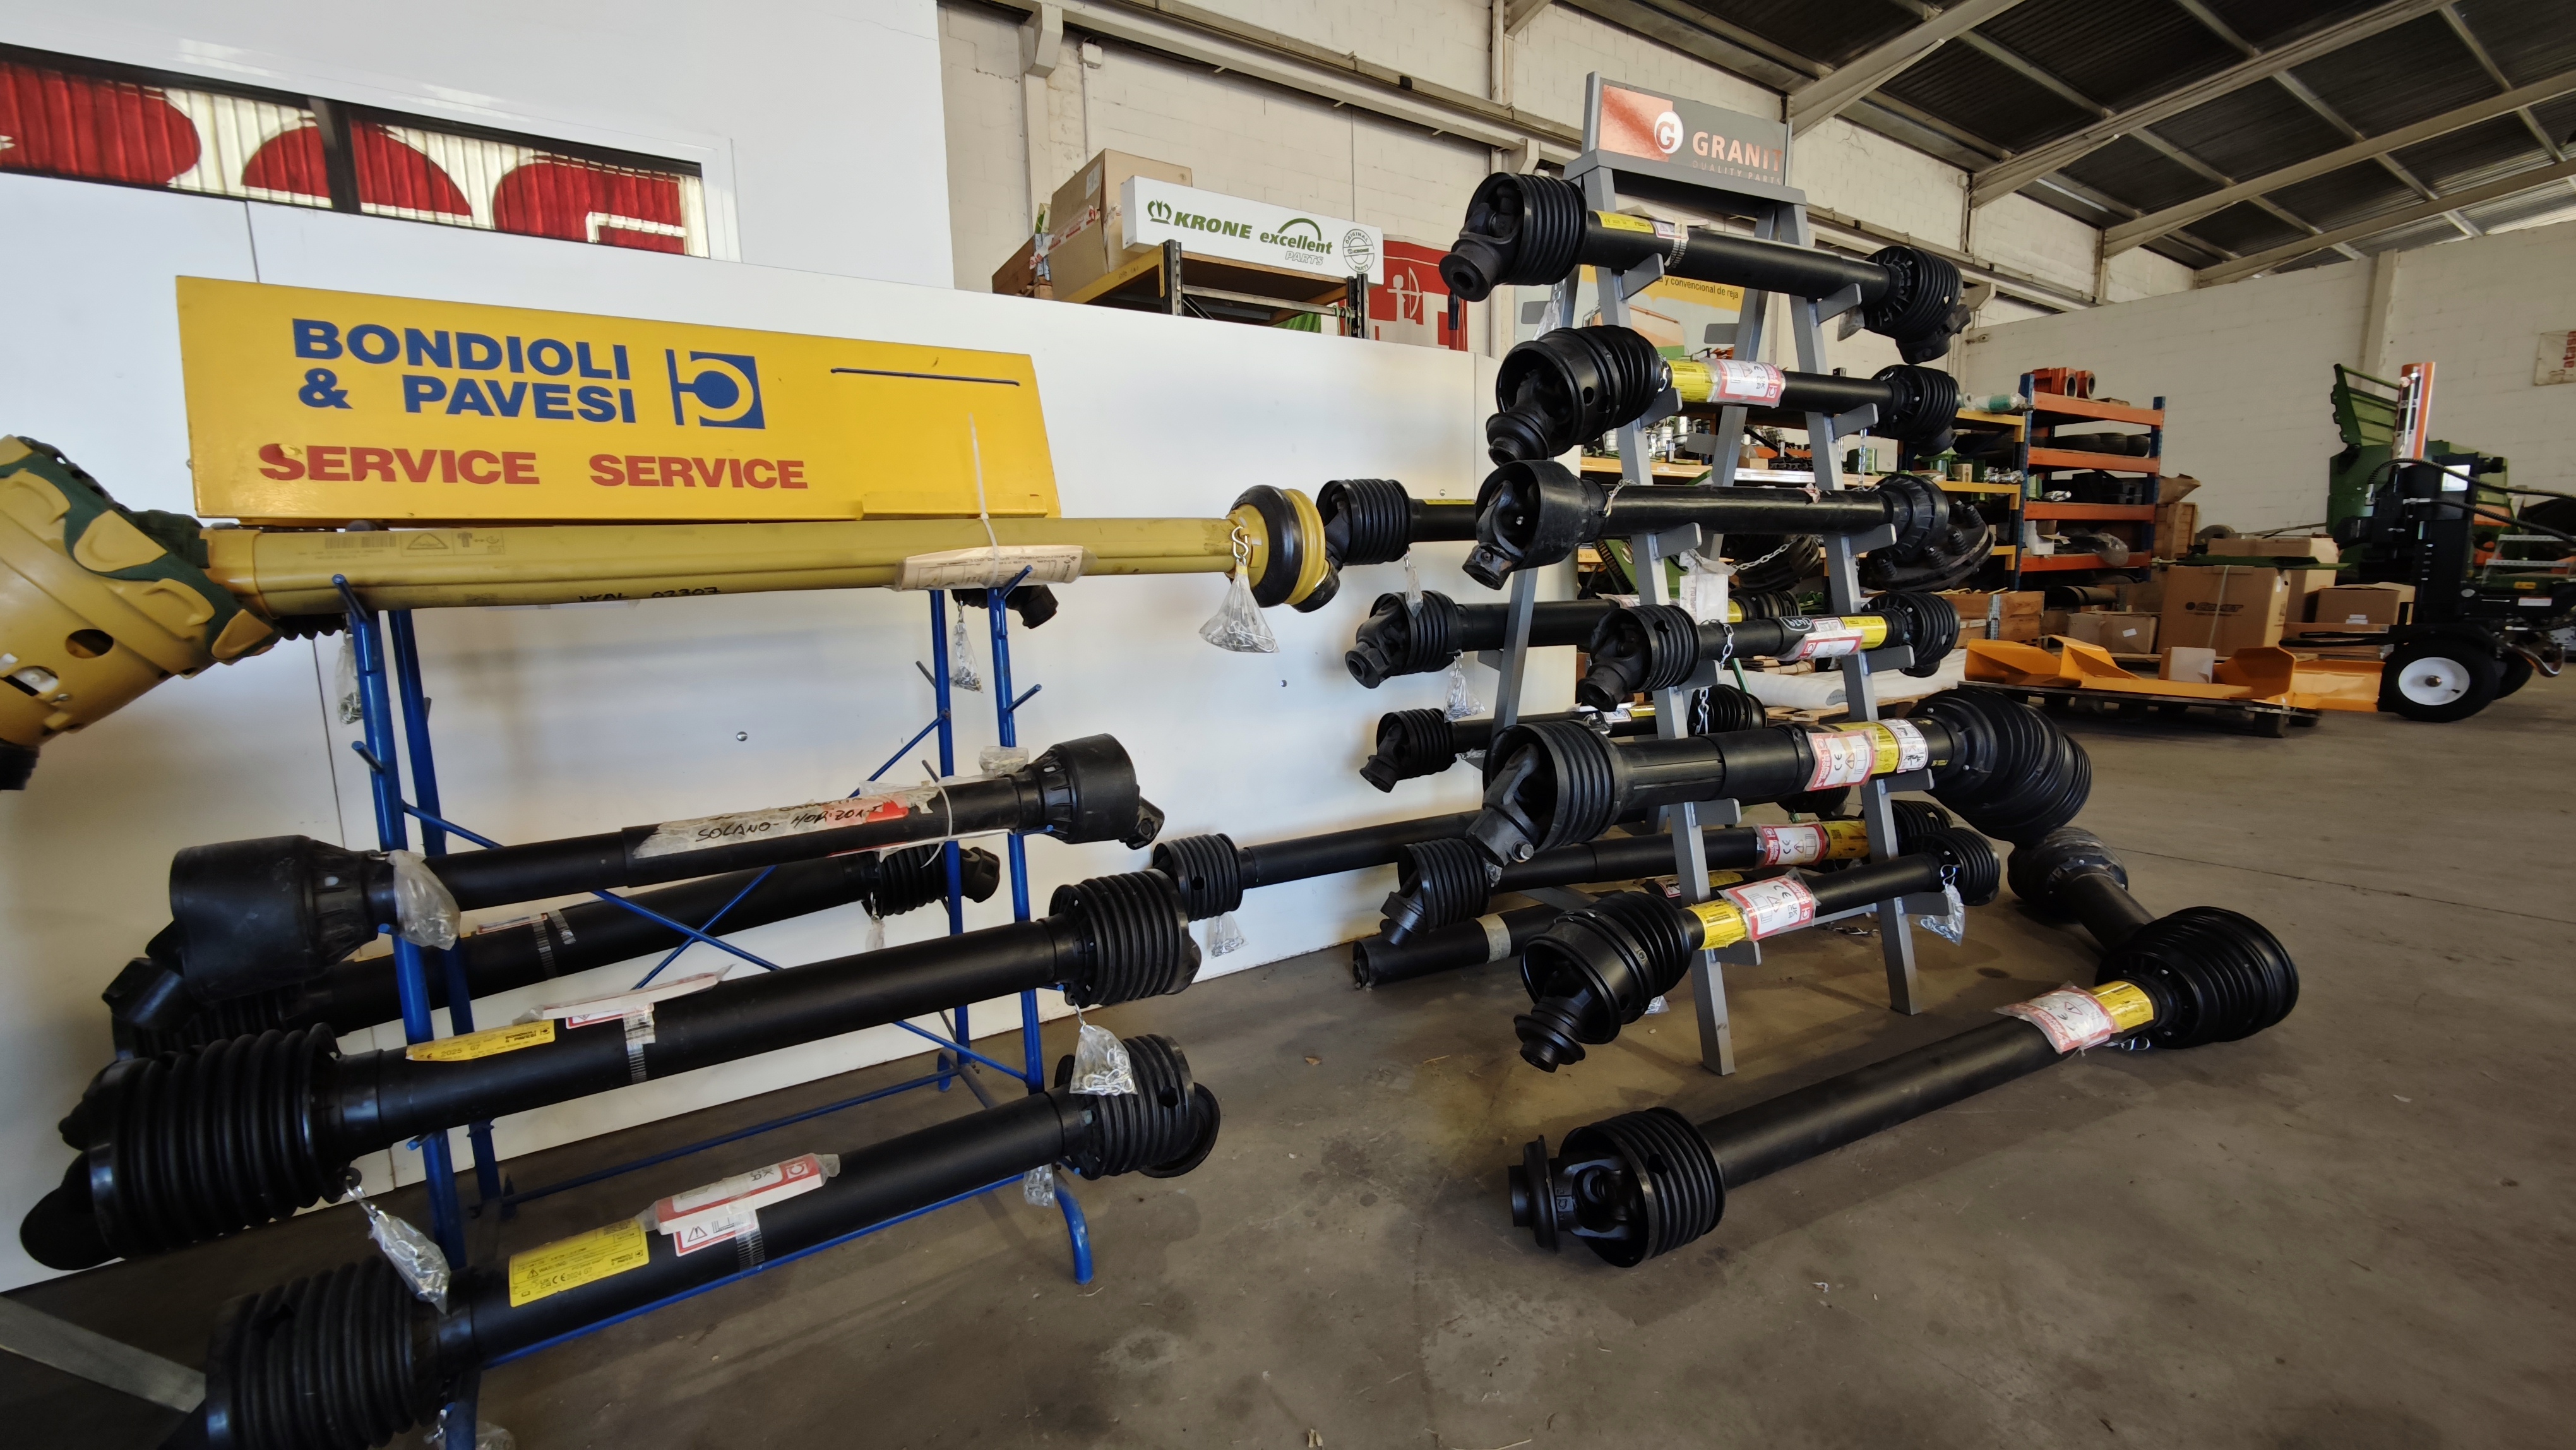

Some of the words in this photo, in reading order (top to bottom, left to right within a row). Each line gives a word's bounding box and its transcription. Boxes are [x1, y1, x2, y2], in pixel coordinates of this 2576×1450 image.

[1656, 121, 1675, 150] G
[1693, 131, 1782, 172] GRANIT
[1692, 160, 1742, 177] QUALITY
[1748, 172, 1782, 186] PARTS
[1173, 211, 1253, 239] KRONE
[1260, 231, 1333, 255] excellent
[1285, 251, 1324, 266] PARTS
[1664, 277, 1669, 286] y
[1671, 277, 1715, 294] convencional
[1717, 286, 1726, 296] de
[1727, 290, 1739, 300] reja
[292, 318, 631, 380] BONDIOLI
[298, 368, 352, 410] &
[402, 374, 636, 424] PAVESI
[258, 443, 540, 486] SERVICE
[589, 454, 809, 489] SERVICE
[441, 1048, 463, 1057] 2025
